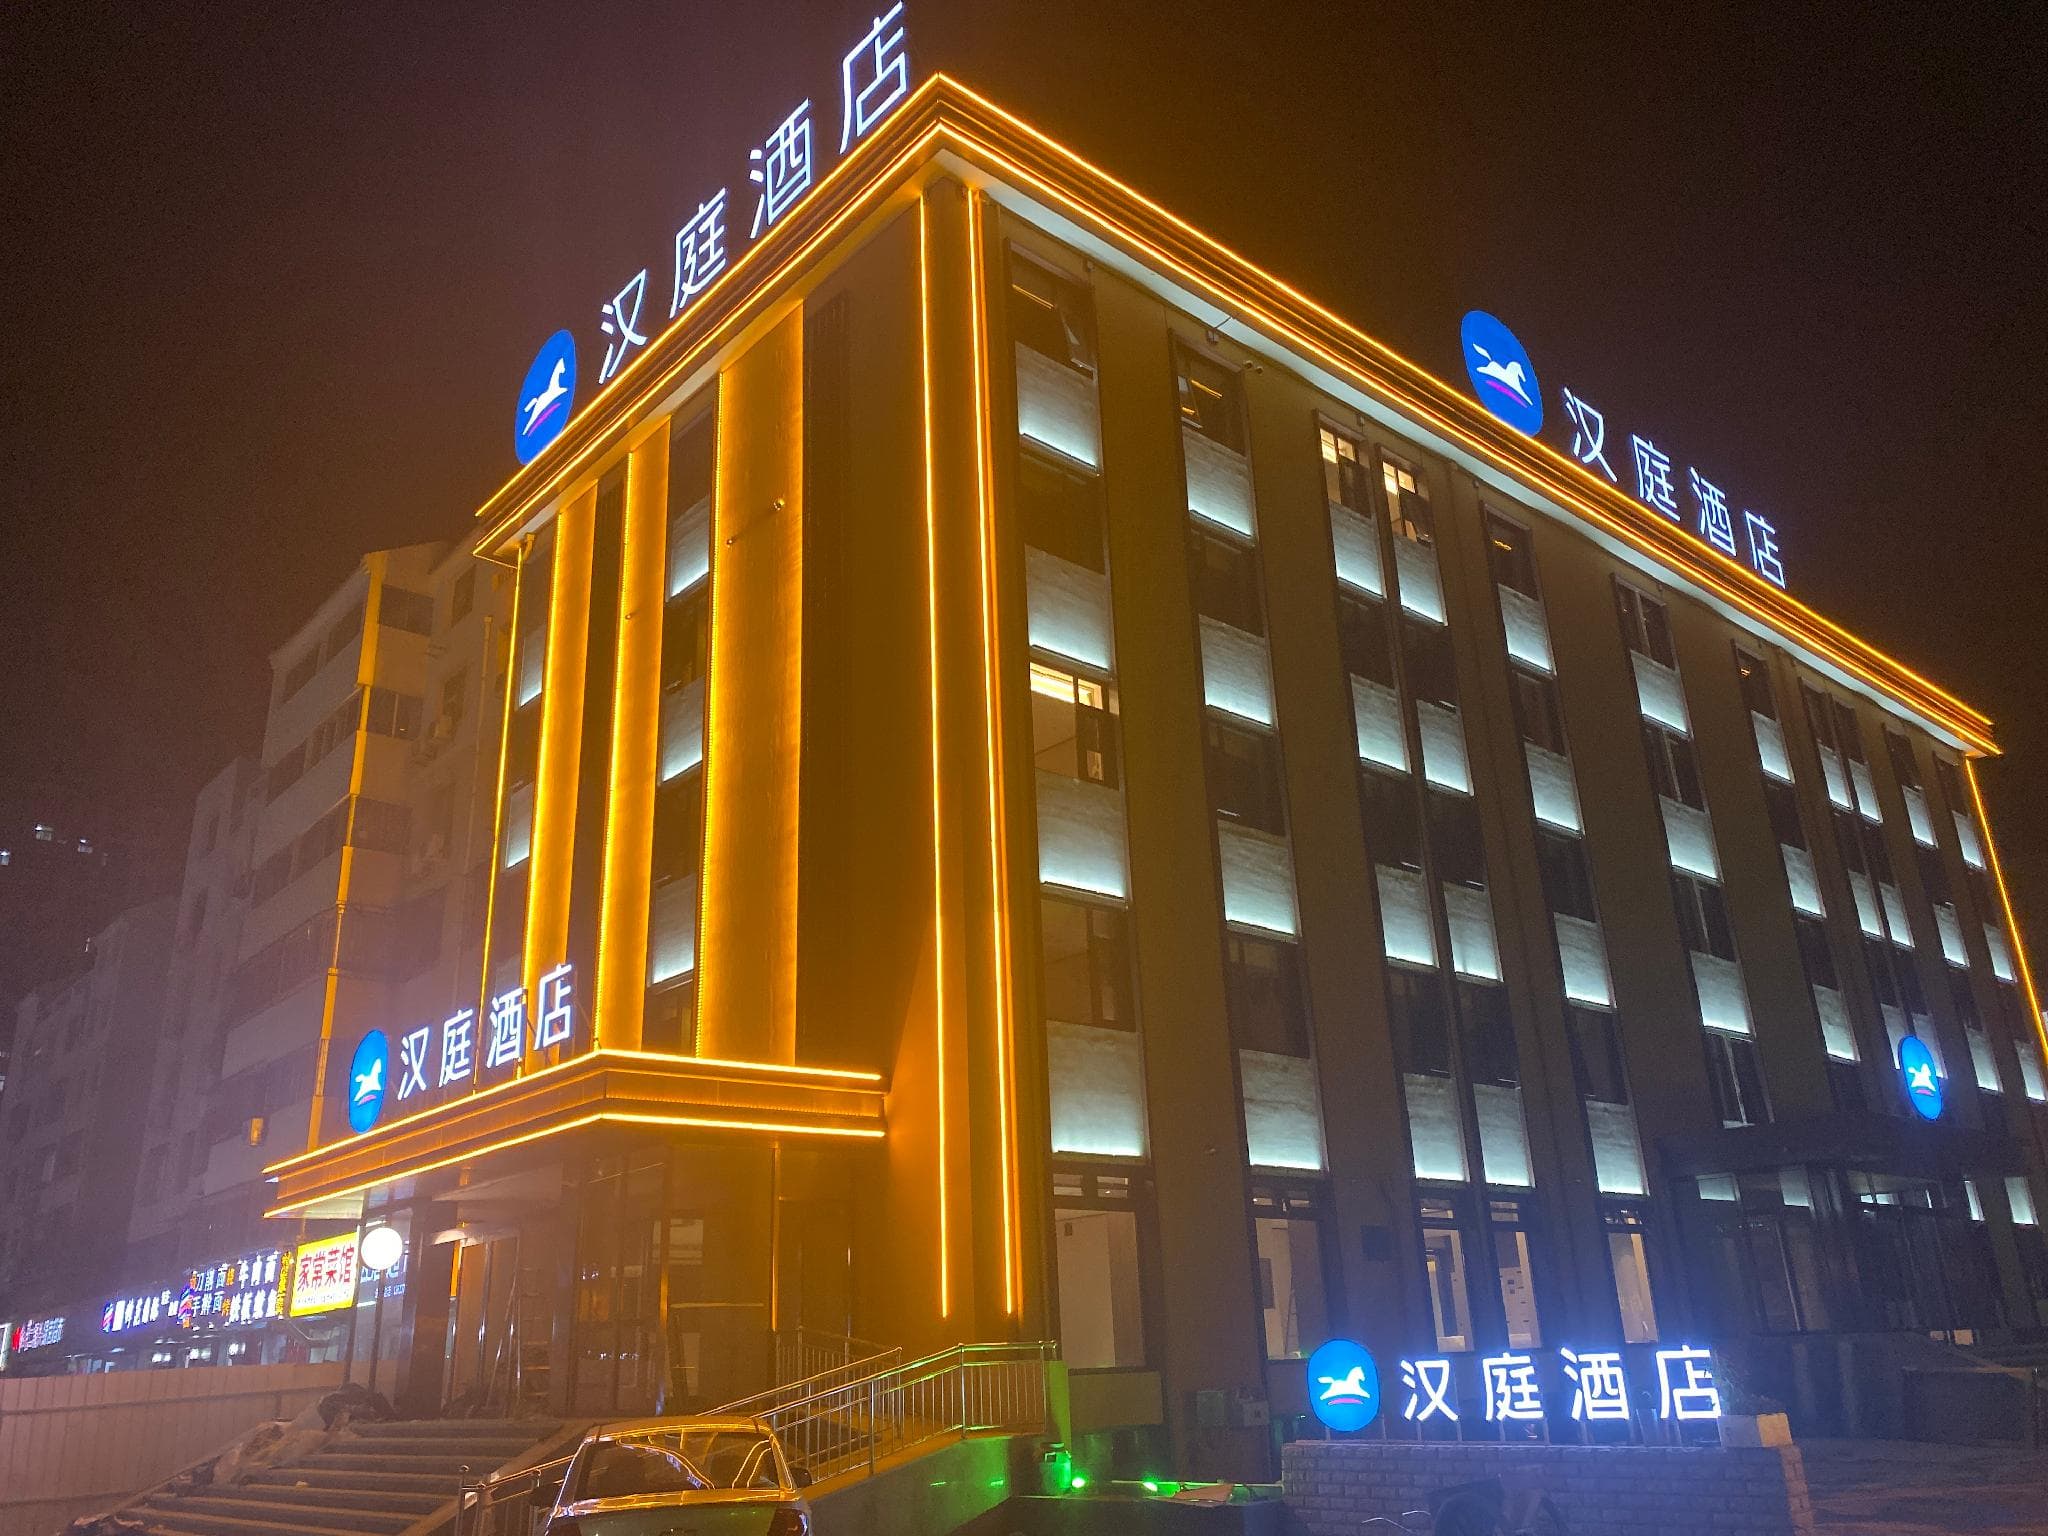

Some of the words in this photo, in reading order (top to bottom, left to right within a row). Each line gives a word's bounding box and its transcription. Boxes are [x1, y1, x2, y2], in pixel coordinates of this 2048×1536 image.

[599, 2, 907, 384] 汉庭酒店
[1563, 387, 1786, 589] 汉庭酒店
[397, 964, 572, 1100] 汉庭酒店
[297, 1244, 355, 1292] 家常菜馆
[1400, 1345, 1721, 1421] 汉庭酒店
